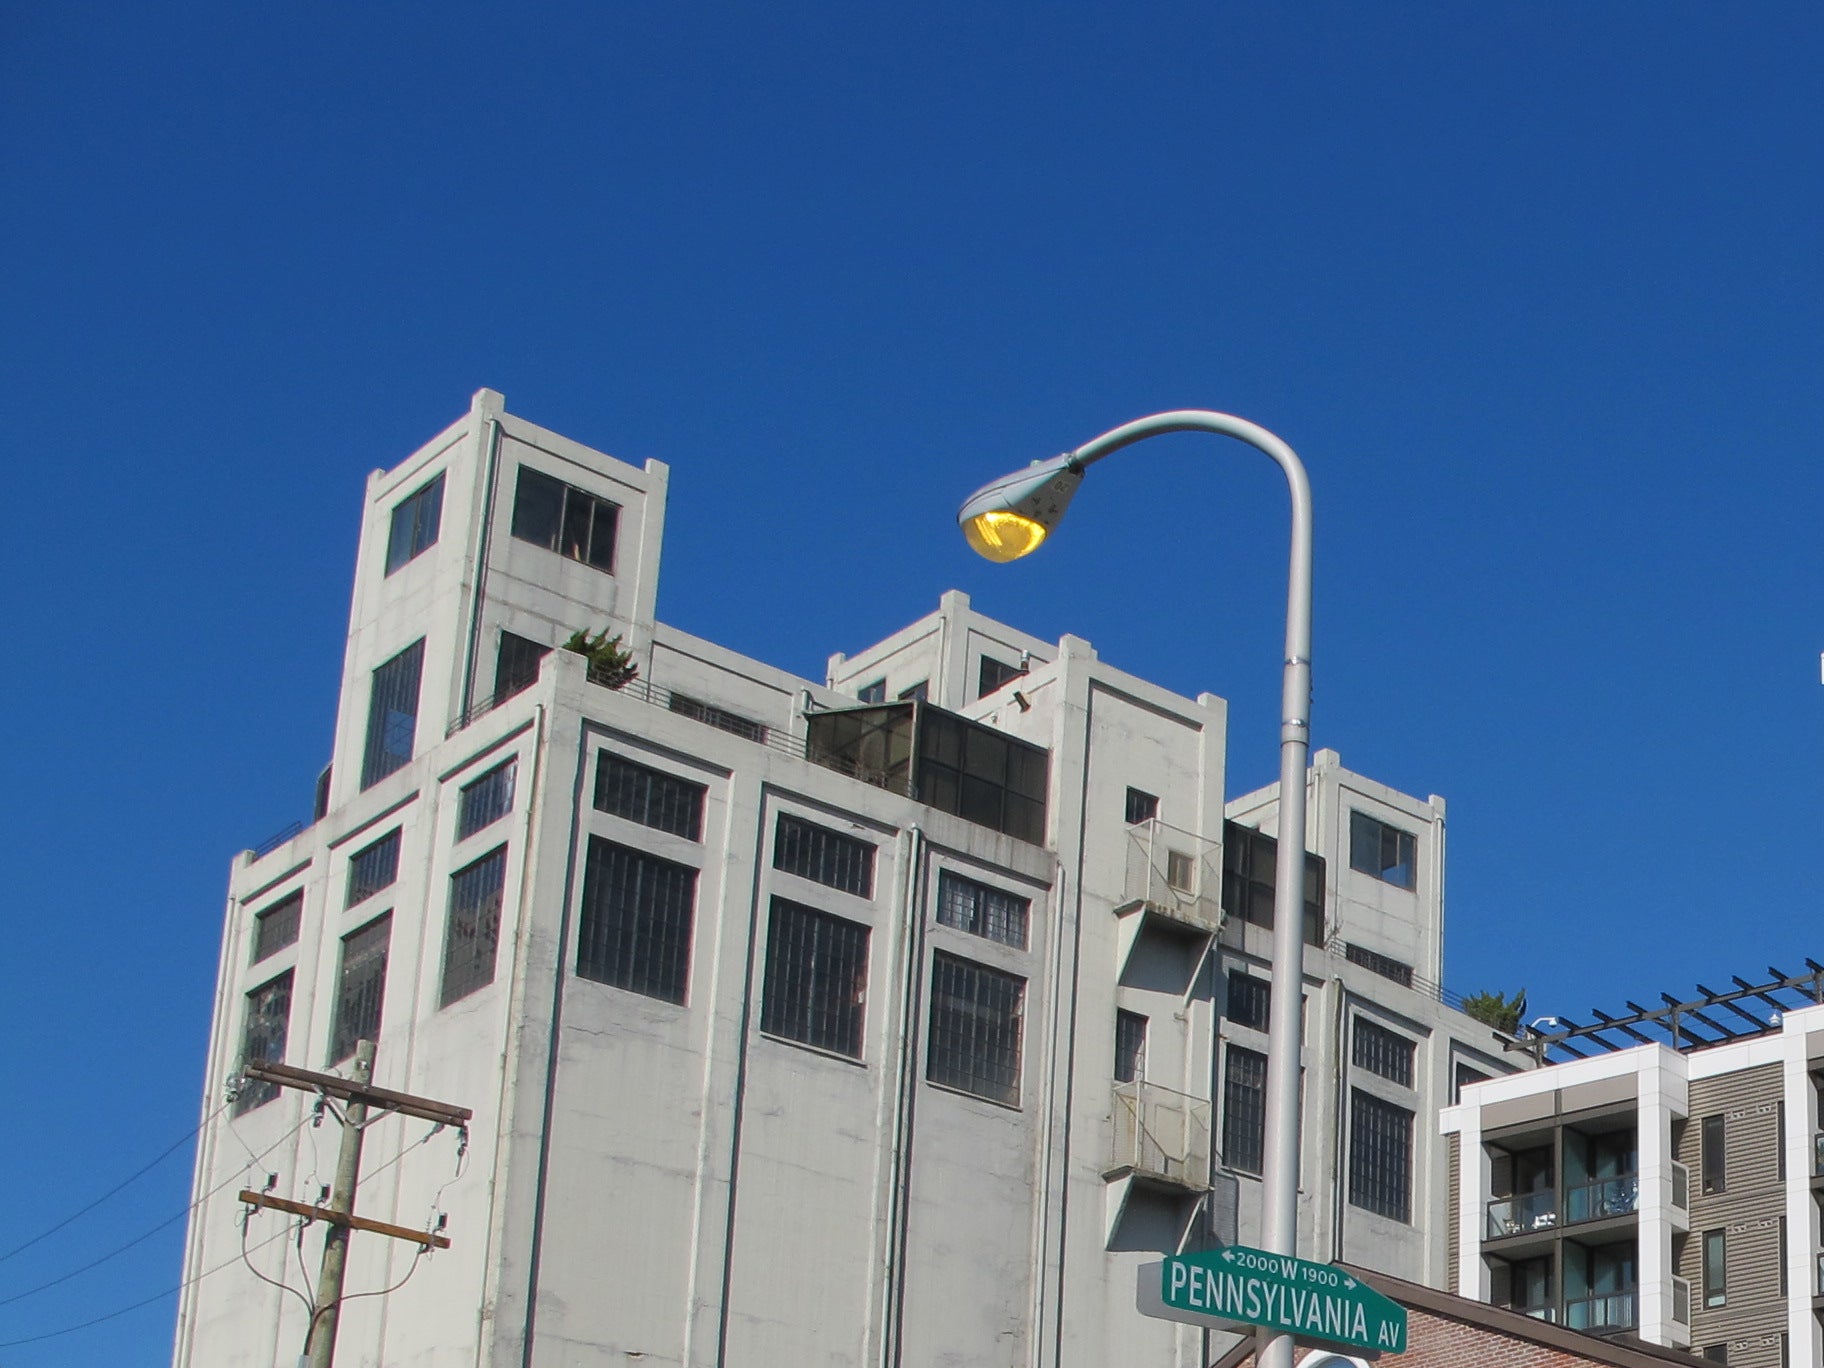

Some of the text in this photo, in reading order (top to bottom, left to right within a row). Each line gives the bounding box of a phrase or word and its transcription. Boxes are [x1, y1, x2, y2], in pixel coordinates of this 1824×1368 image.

[1237, 1252, 1339, 1288] 2000 W 1900
[1171, 1261, 1400, 1348] PENNSYLVANIA AV
